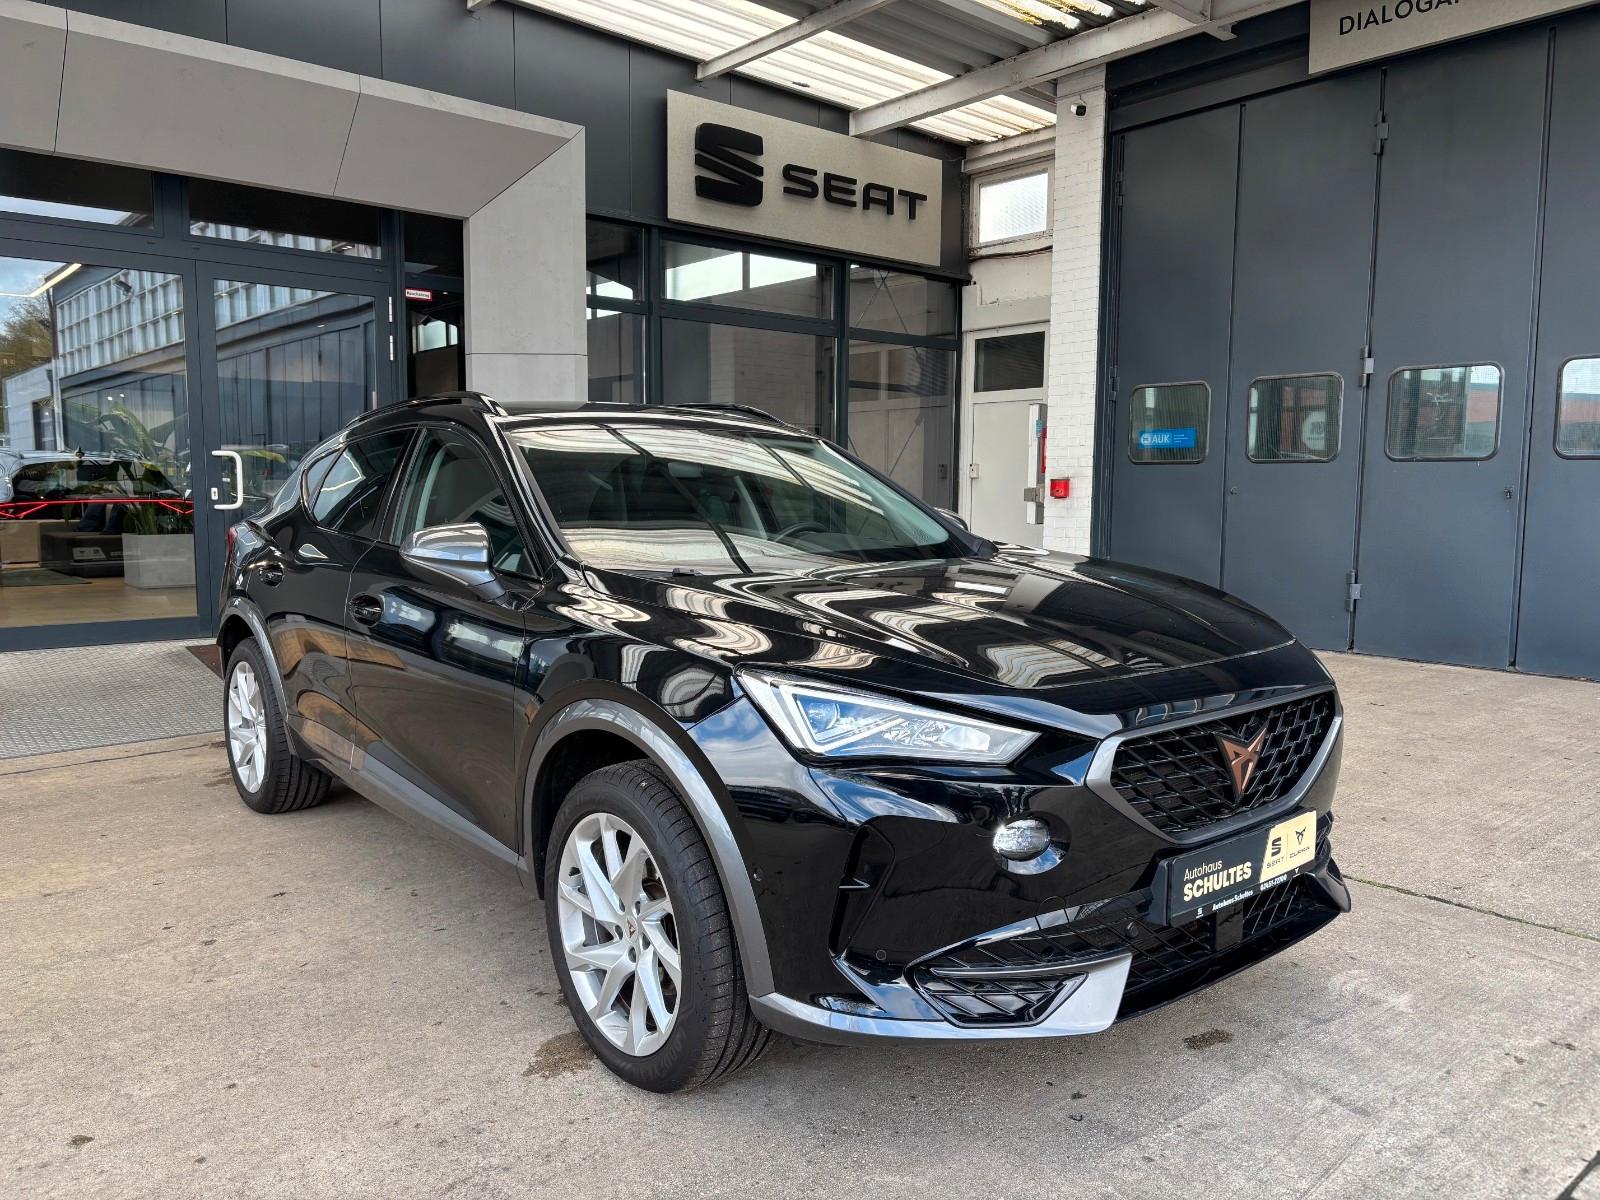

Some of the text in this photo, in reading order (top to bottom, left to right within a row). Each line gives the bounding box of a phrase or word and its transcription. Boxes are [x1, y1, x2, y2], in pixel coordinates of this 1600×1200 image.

[1339, 0, 1459, 36] DIALOG
[782, 163, 928, 220] SEAT
[1183, 860, 1223, 882] Autohaus
[1183, 861, 1252, 902] SCHULTES
